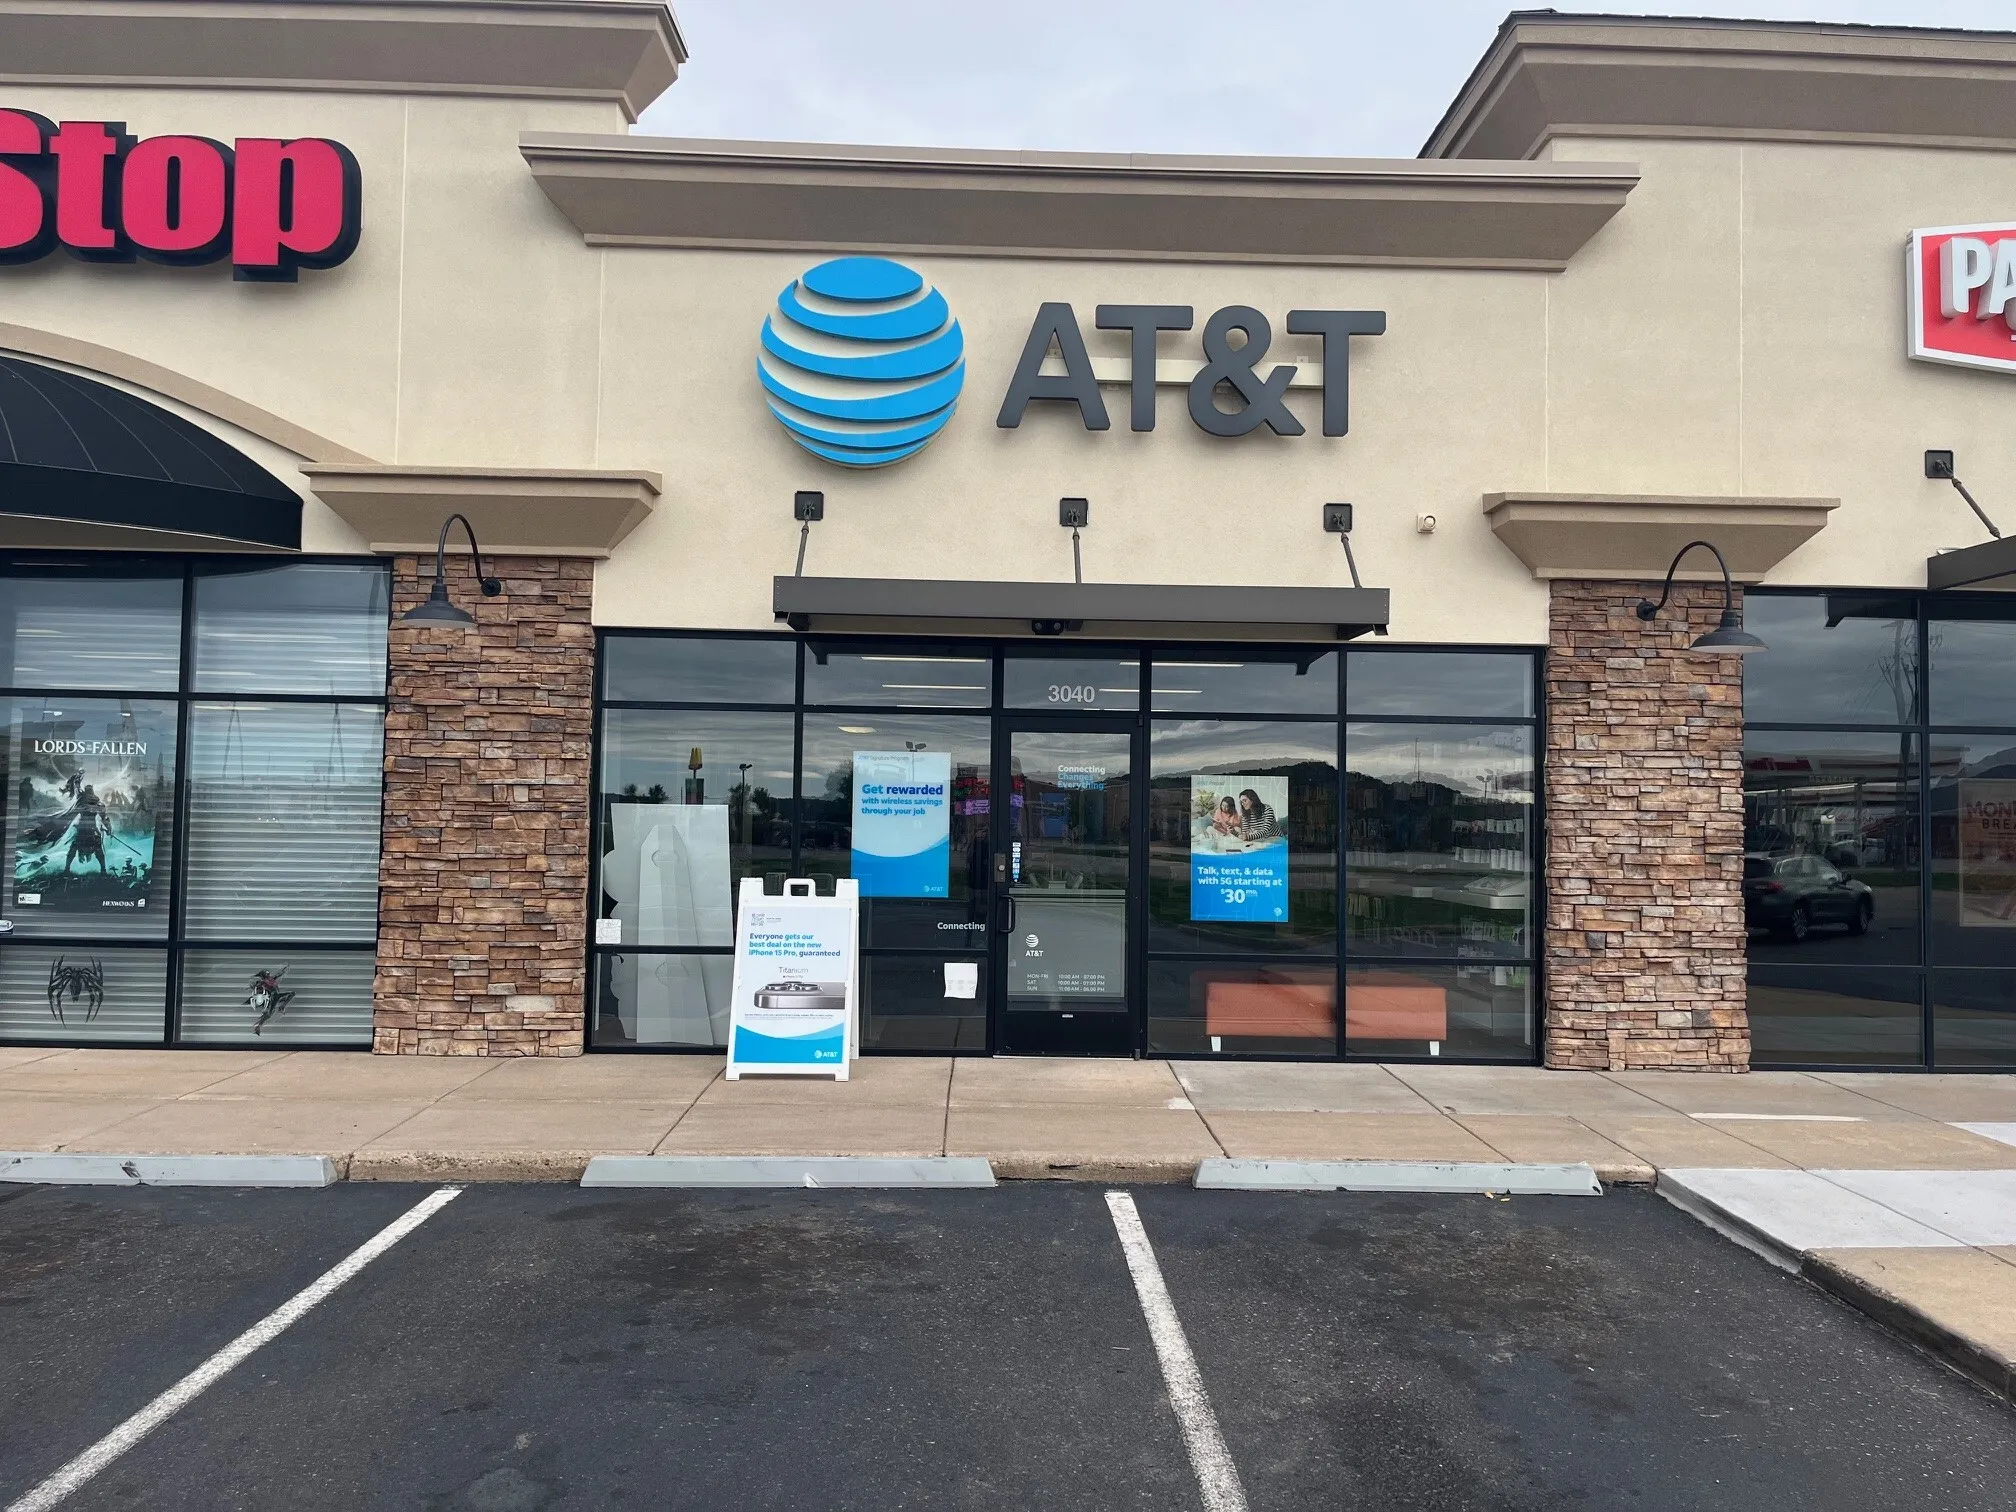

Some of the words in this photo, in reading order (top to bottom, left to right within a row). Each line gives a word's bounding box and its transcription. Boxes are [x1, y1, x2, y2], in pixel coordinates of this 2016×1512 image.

[996, 302, 1387, 438] AT&T
[1048, 685, 1096, 703] 3040
[34, 740, 86, 754] LORDS
[93, 741, 147, 755] FALLEN
[1057, 764, 1106, 775] Connecting
[862, 783, 884, 795] Get
[886, 784, 944, 795] rewarded
[1057, 780, 1105, 791] Everything
[861, 796, 879, 805] with
[881, 797, 913, 805] wireless
[914, 798, 943, 807] savings
[861, 807, 893, 816] through
[894, 808, 912, 816] your
[913, 807, 926, 816] job
[1966, 801, 2016, 817] MON
[1982, 818, 2016, 830] BRE
[1197, 866, 1219, 876] Talk,
[1221, 867, 1243, 877] text,
[1244, 867, 1251, 876] &
[1252, 867, 1274, 876] data
[1197, 876, 1219, 885] with
[1220, 877, 1232, 885] 5G
[1233, 877, 1271, 888] starting
[937, 922, 986, 931] Connecting
[749, 932, 784, 941] Everyone
[784, 933, 801, 942] gets
[798, 949, 841, 958] guaranteed
[779, 966, 809, 974] Titanium
